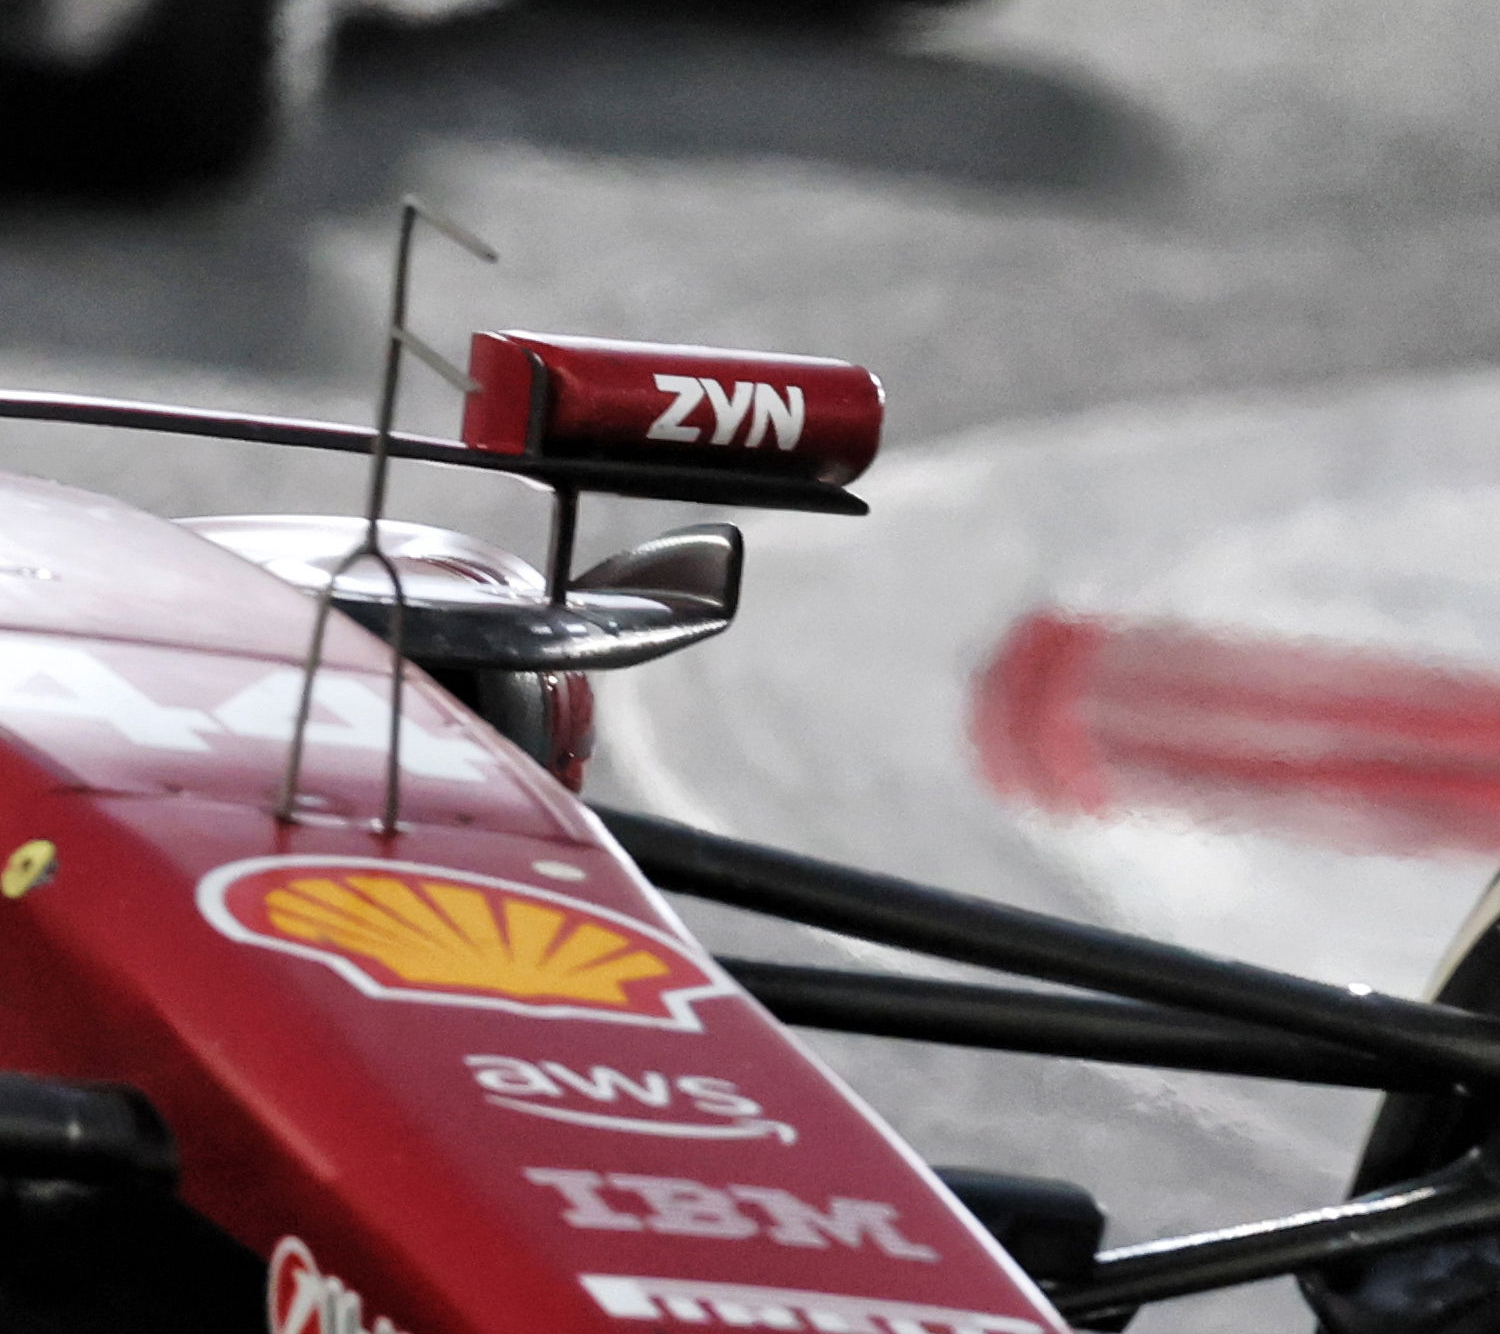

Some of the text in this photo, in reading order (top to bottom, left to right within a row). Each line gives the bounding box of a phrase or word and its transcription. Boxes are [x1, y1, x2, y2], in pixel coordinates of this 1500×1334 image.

[645, 373, 805, 451] ZYN
[462, 1053, 764, 1117] aws
[522, 1166, 942, 1264] IBM
